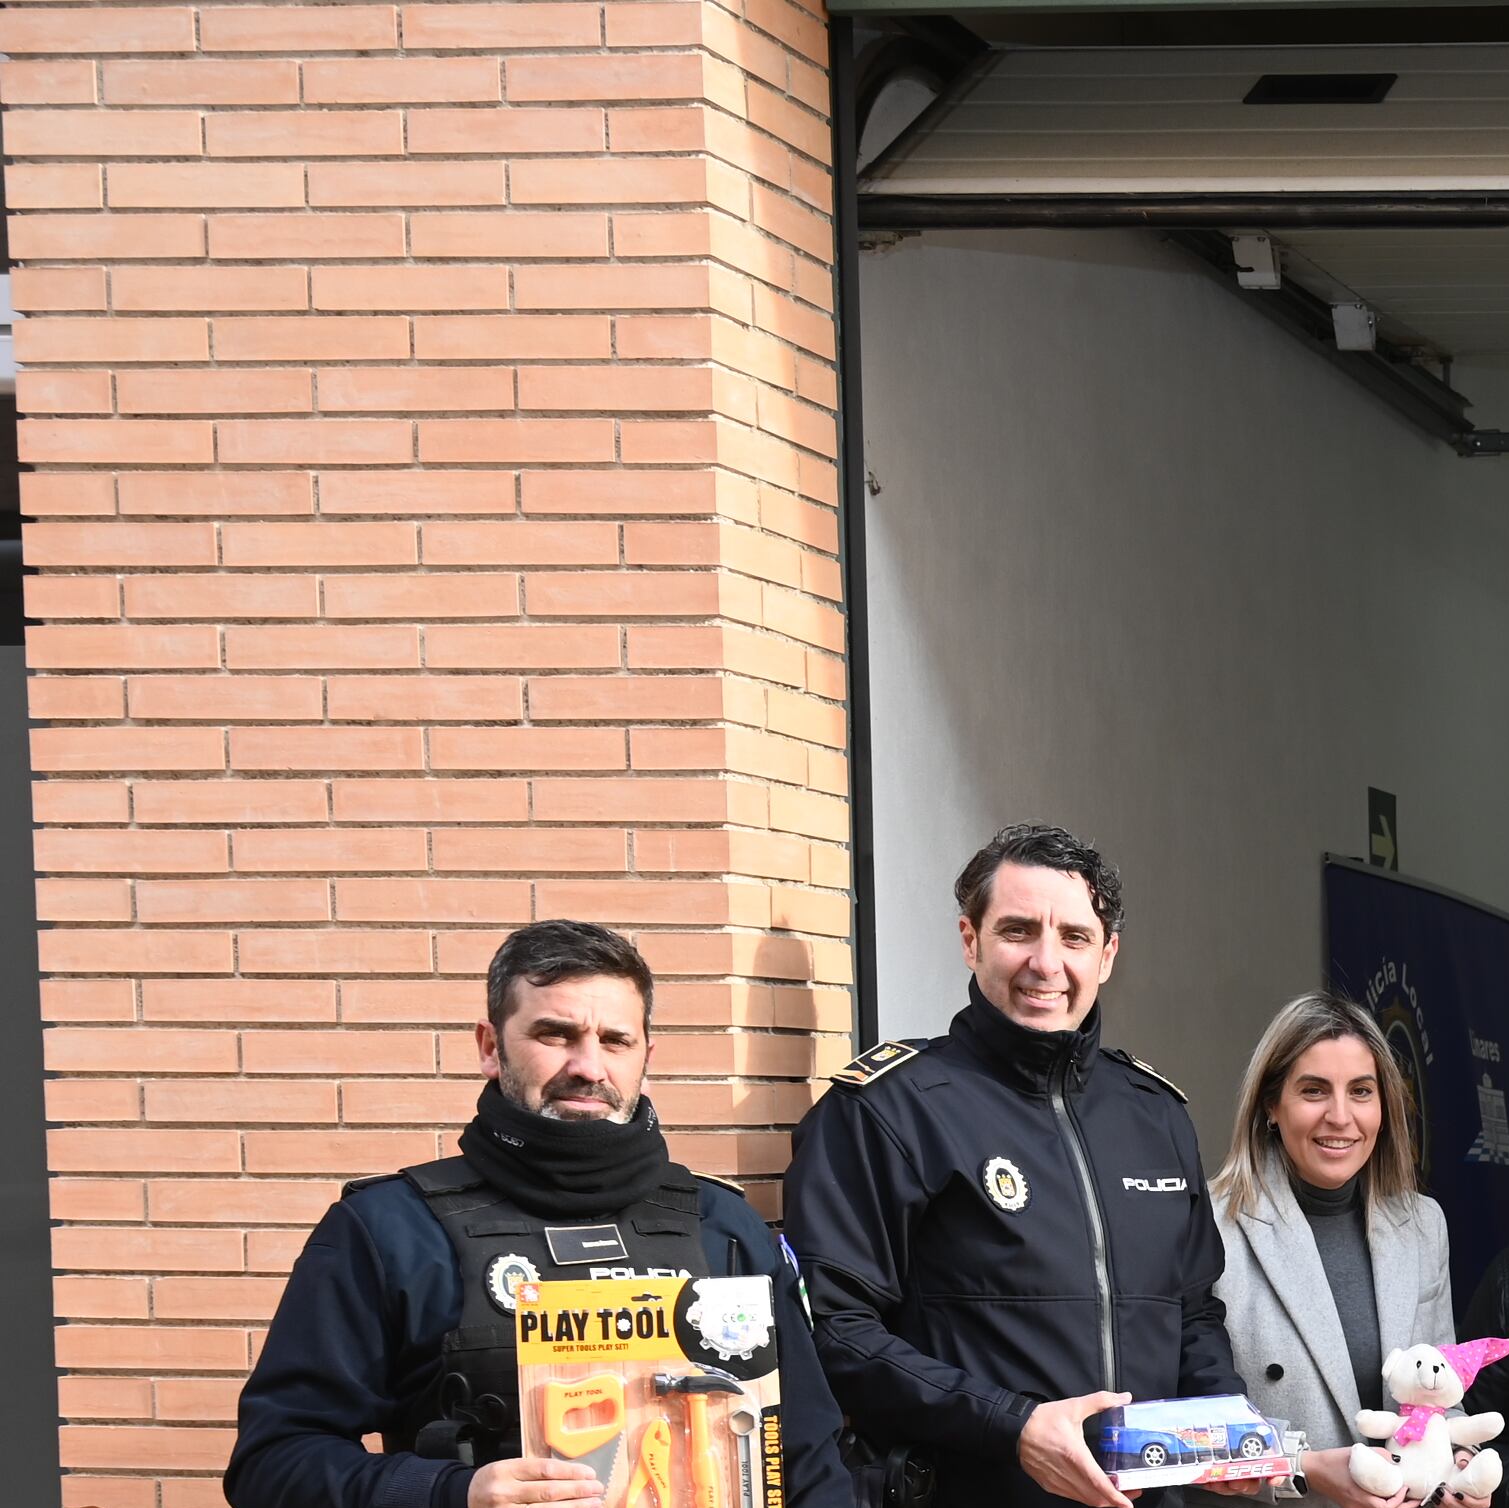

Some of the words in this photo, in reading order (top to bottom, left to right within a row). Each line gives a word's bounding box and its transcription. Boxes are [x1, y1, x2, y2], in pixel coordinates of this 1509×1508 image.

[1366, 955, 1397, 1012] licía
[1400, 961, 1435, 1067] Local
[521, 1308, 589, 1343] PLAY
[597, 1306, 669, 1341] TOOL
[553, 1344, 574, 1353] SUPER
[576, 1344, 597, 1352] TOOLS
[598, 1344, 613, 1352] PLAY
[564, 1391, 583, 1399] PLAY
[586, 1388, 603, 1396] TOOL
[763, 1415, 780, 1455] TOOLS
[765, 1456, 781, 1488] PLAY
